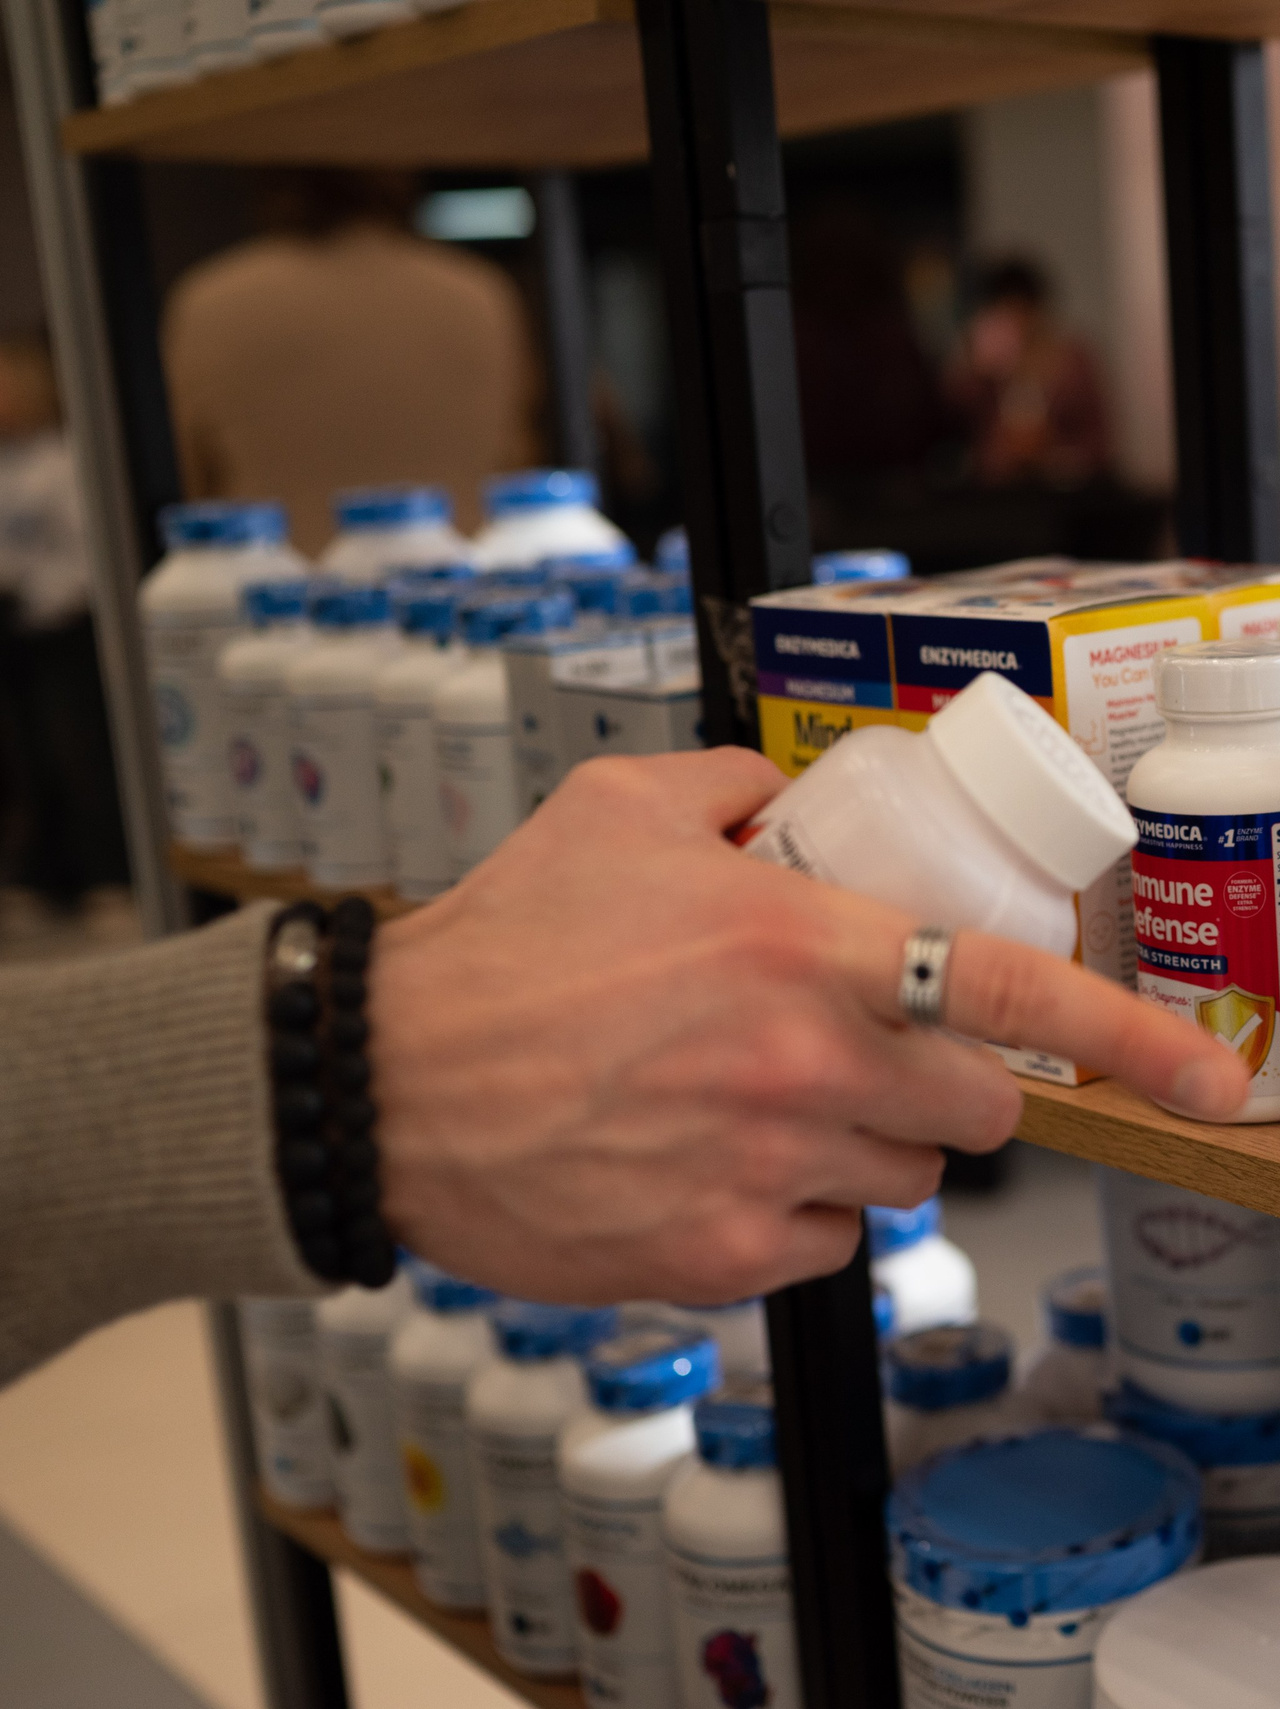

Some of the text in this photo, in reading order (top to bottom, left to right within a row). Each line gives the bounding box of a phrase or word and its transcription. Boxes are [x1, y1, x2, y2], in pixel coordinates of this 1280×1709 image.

[920, 645, 1018, 670] ENZYMEDICA
[1166, 841, 1204, 851] HAPPINESS
[1218, 829, 1235, 848] #1
[1237, 827, 1263, 835] ENZYME
[1227, 884, 1262, 893] ENZYME
[1134, 906, 1219, 946] efense
[1151, 951, 1222, 970] STRENGTH
